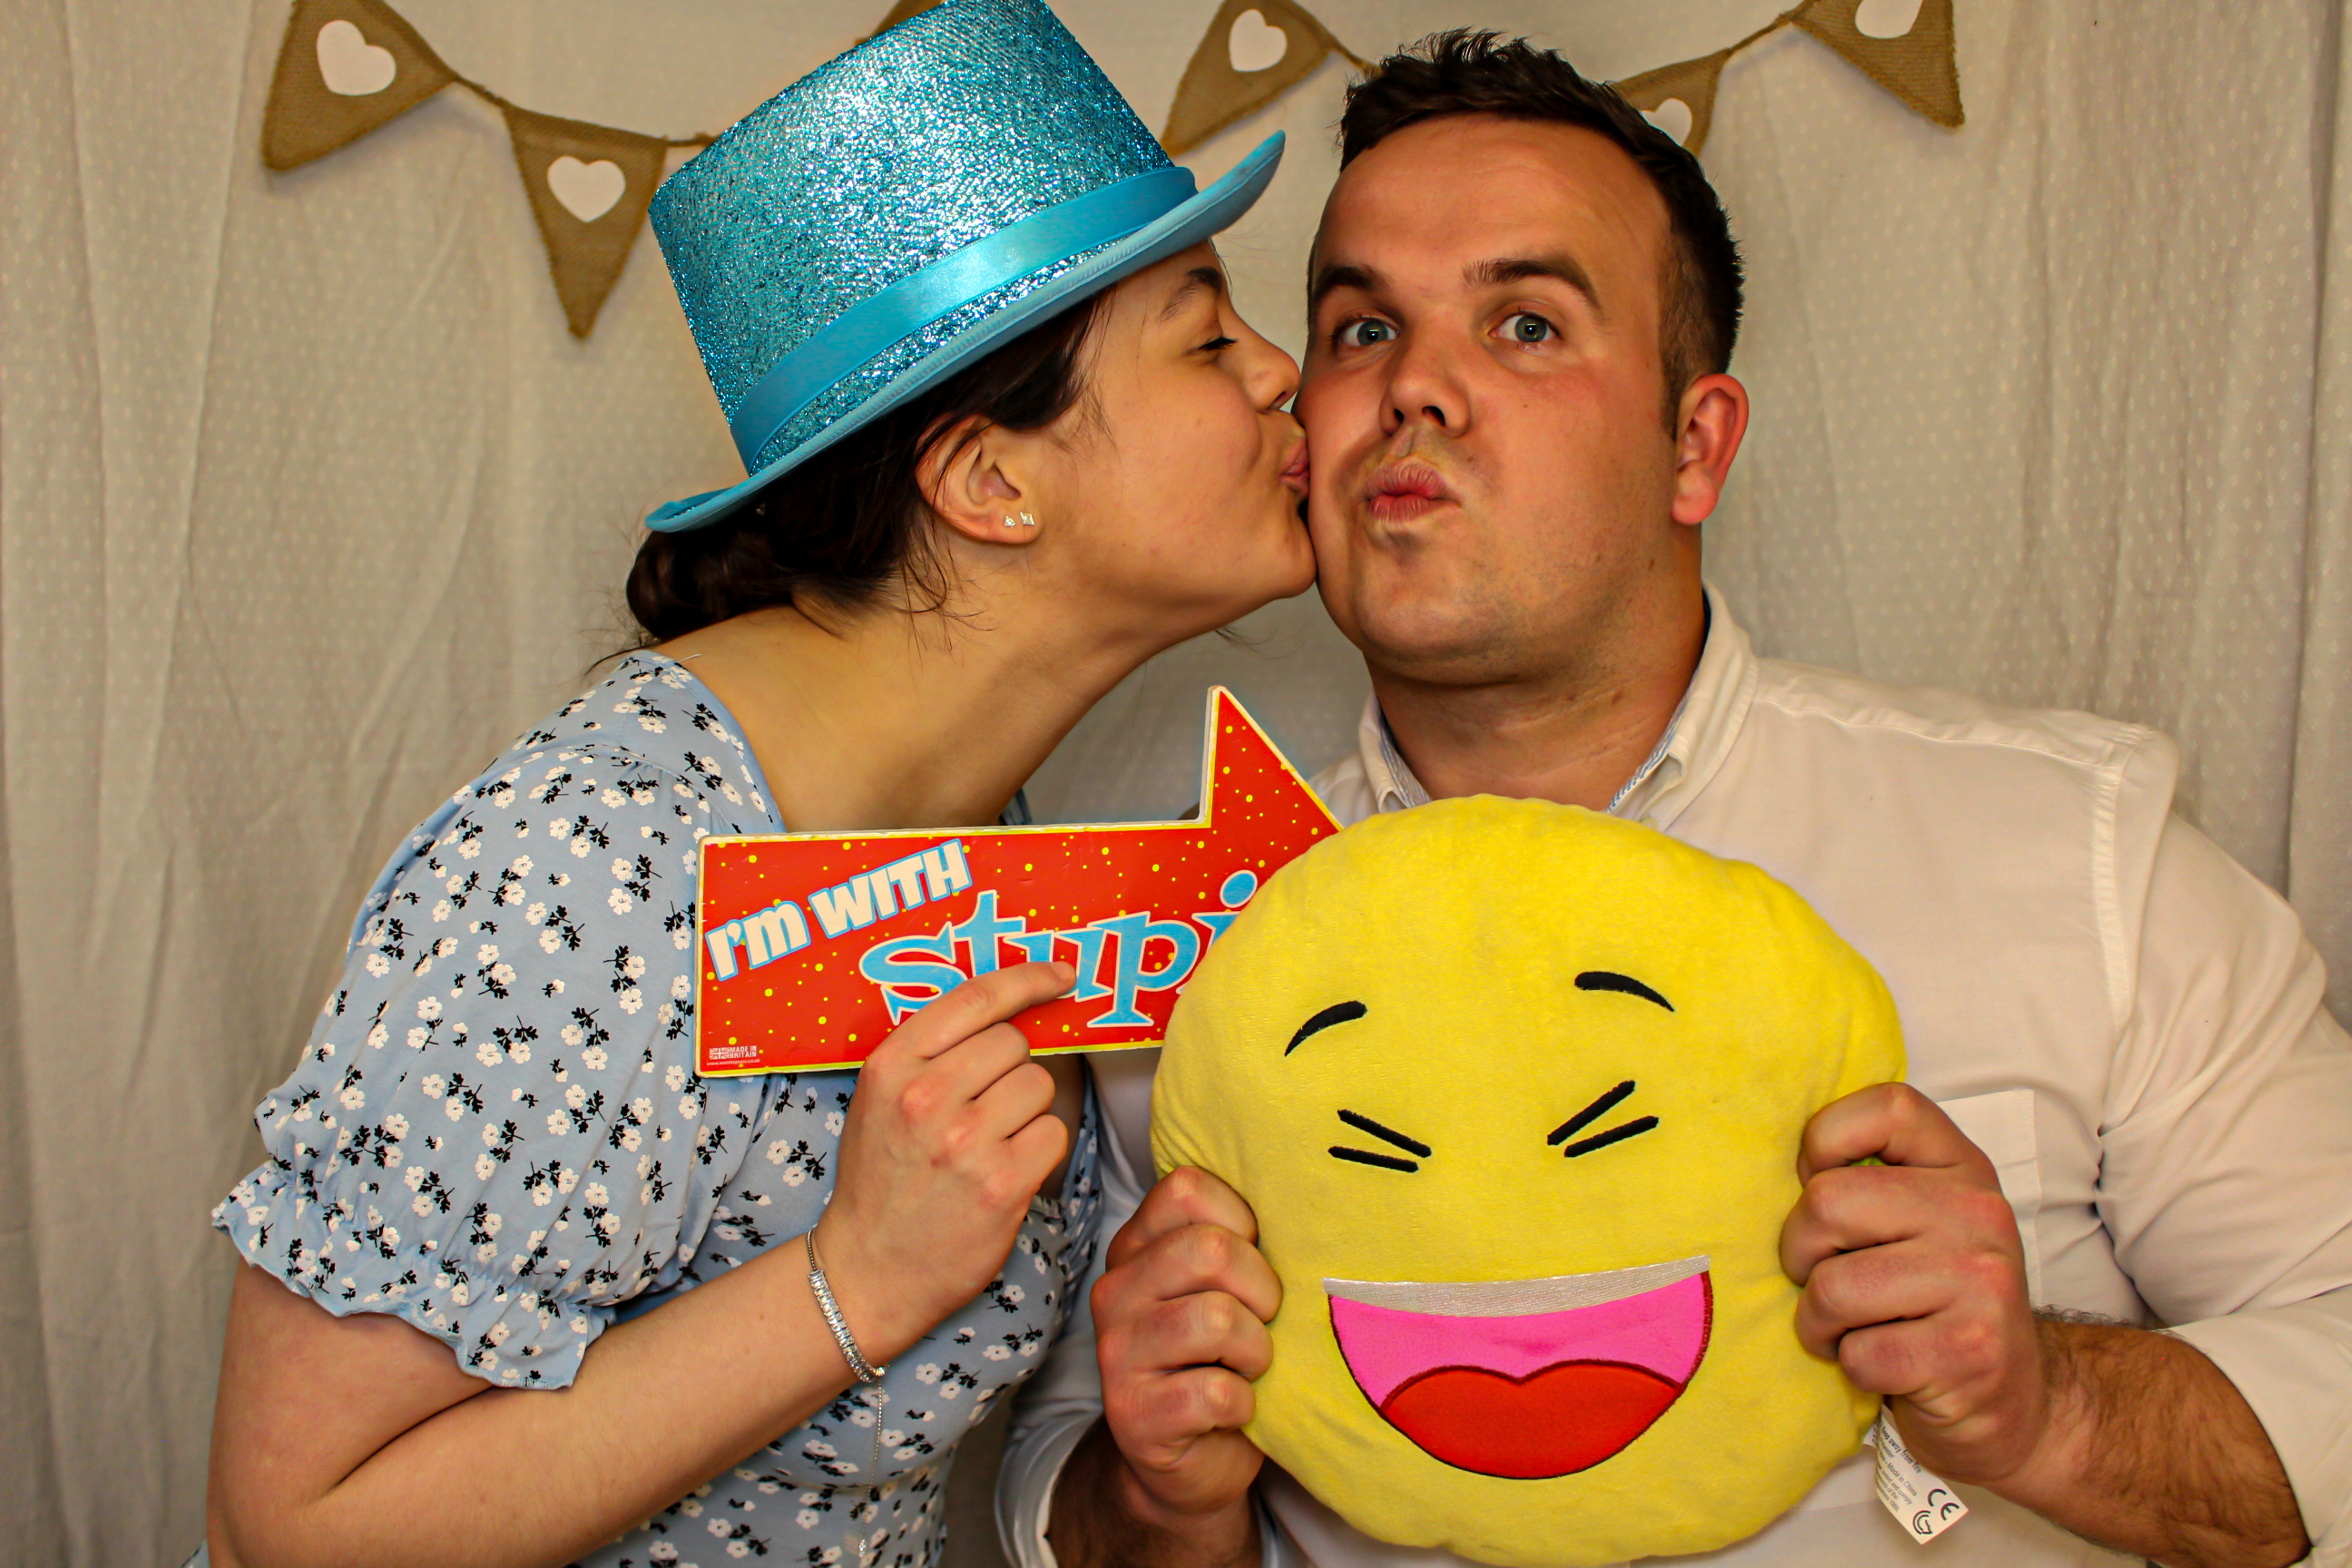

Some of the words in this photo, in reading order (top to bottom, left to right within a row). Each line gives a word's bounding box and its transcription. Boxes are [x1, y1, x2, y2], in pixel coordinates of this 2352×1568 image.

[808, 838, 974, 939] WITH
[1888, 1438, 1902, 1454] away
[1900, 1449, 1914, 1465] from
[1911, 1461, 1923, 1474] fire
[1887, 1462, 1900, 1478] Made
[1903, 1481, 1917, 1497] China
